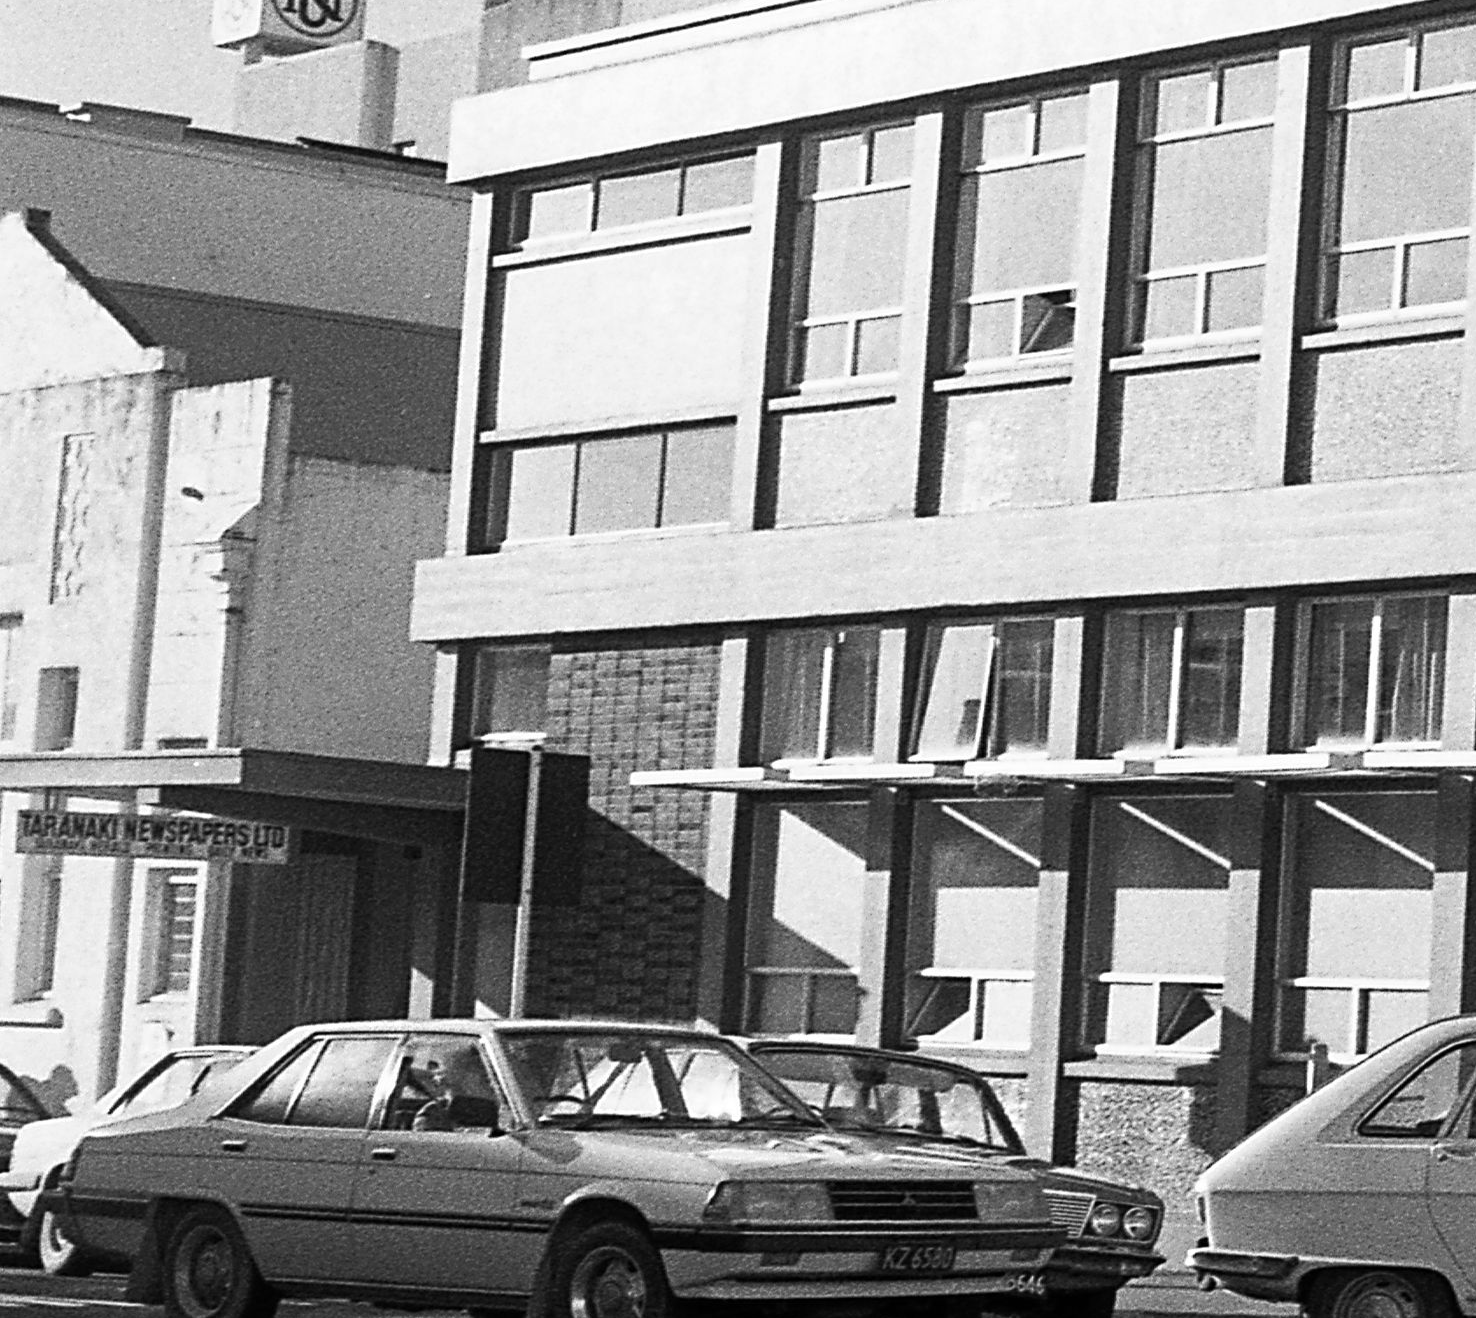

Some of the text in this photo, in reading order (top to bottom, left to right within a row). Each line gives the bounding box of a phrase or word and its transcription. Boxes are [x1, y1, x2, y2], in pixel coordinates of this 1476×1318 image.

[21, 813, 119, 838] TARANAKI
[124, 816, 250, 847] NEWSPAPERS
[252, 825, 287, 849] LTD
